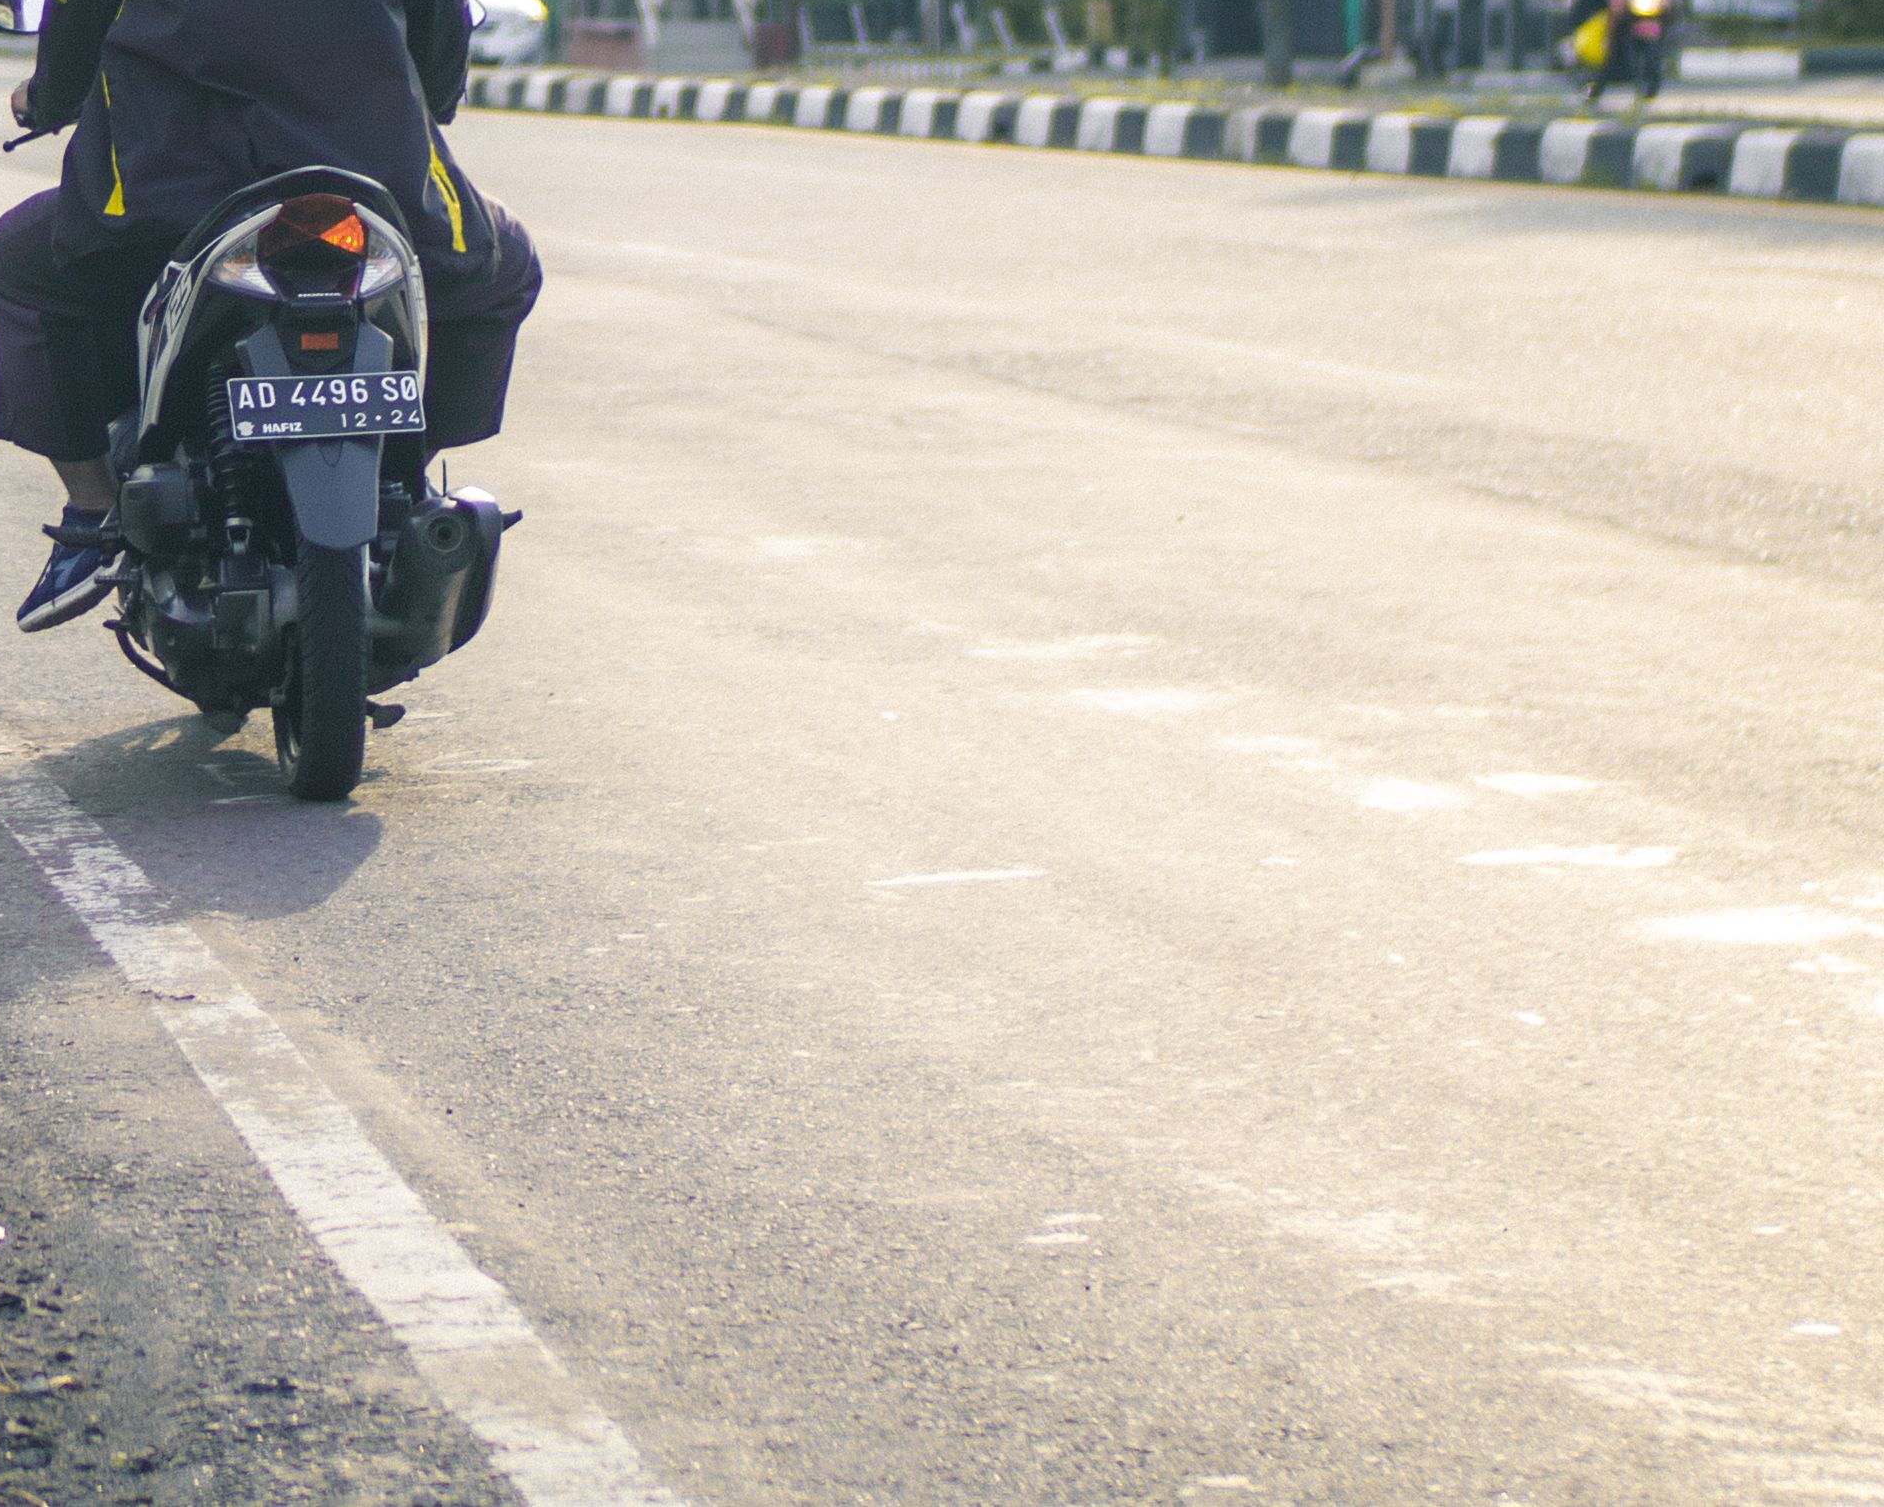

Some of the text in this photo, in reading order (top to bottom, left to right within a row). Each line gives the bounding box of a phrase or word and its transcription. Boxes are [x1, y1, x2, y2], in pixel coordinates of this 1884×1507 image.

[238, 382, 276, 409] AD
[291, 378, 368, 406] 4496
[262, 421, 303, 433] HAFIZ
